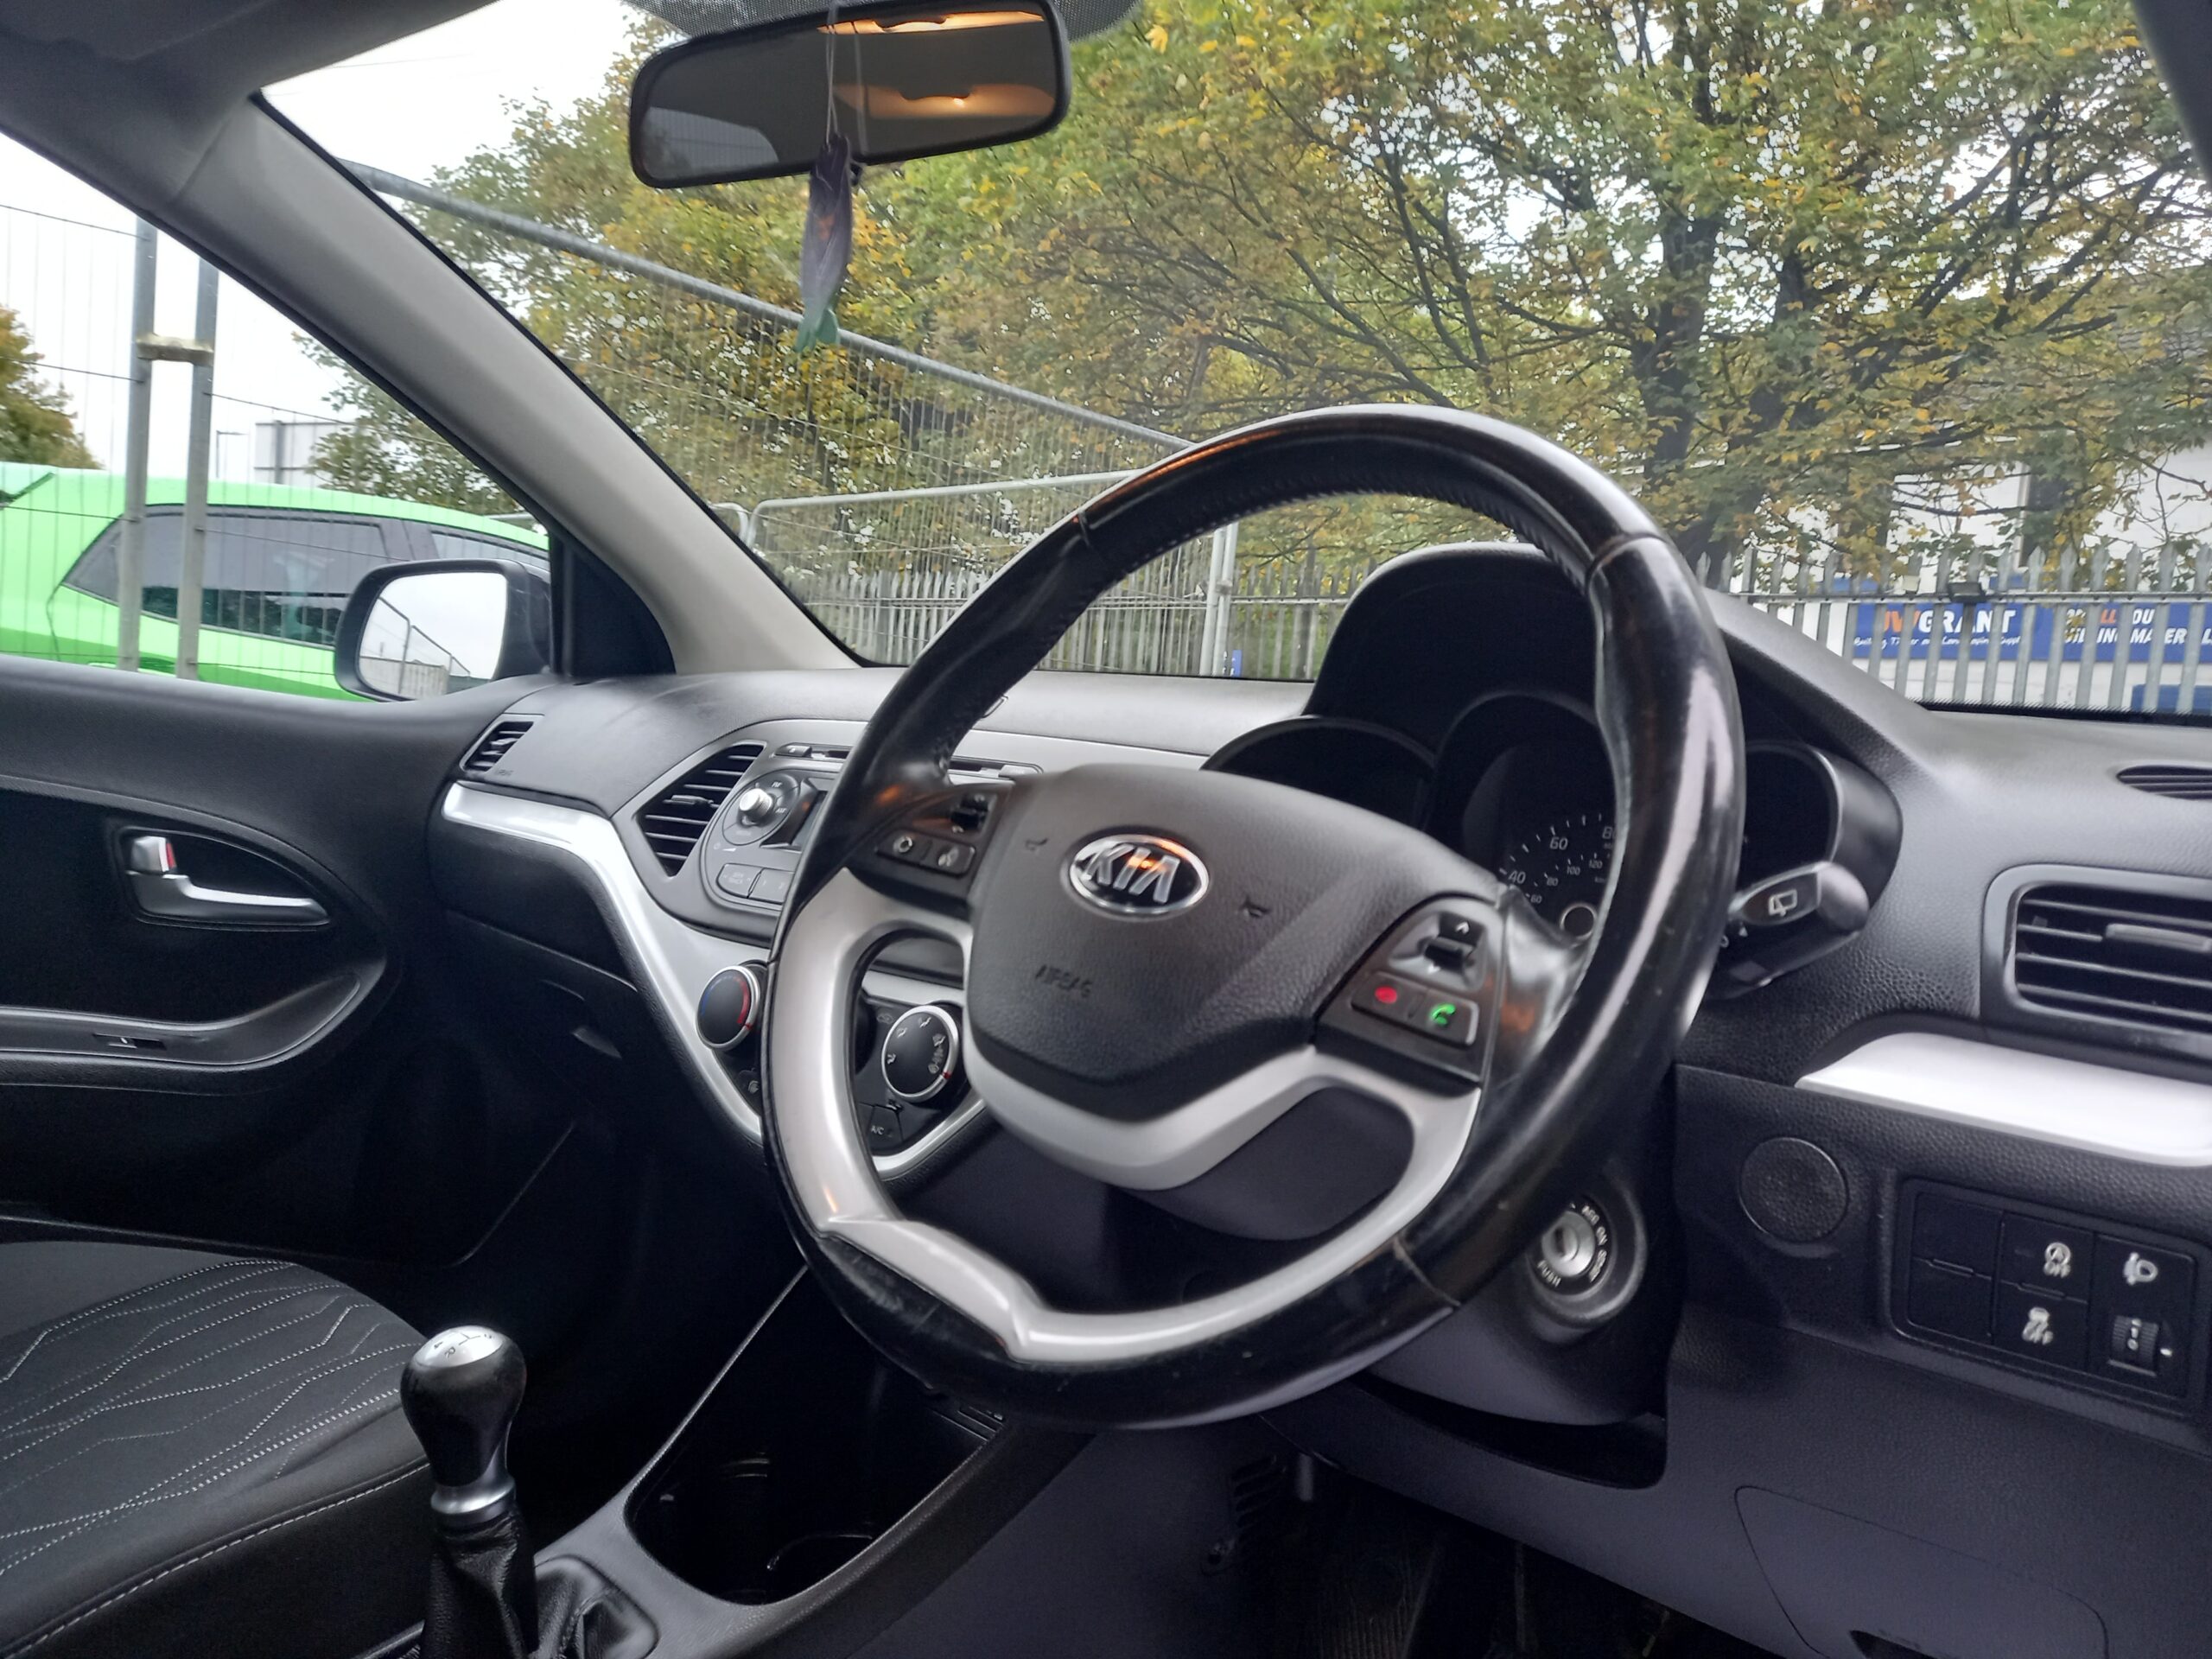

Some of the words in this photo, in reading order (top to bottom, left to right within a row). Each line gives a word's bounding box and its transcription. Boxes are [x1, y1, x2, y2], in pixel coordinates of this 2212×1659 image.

[1549, 836, 1568, 850] 60
[1084, 843, 1181, 904] KIA
[1509, 870, 1526, 884] 40
[871, 1125, 885, 1135] A/C
